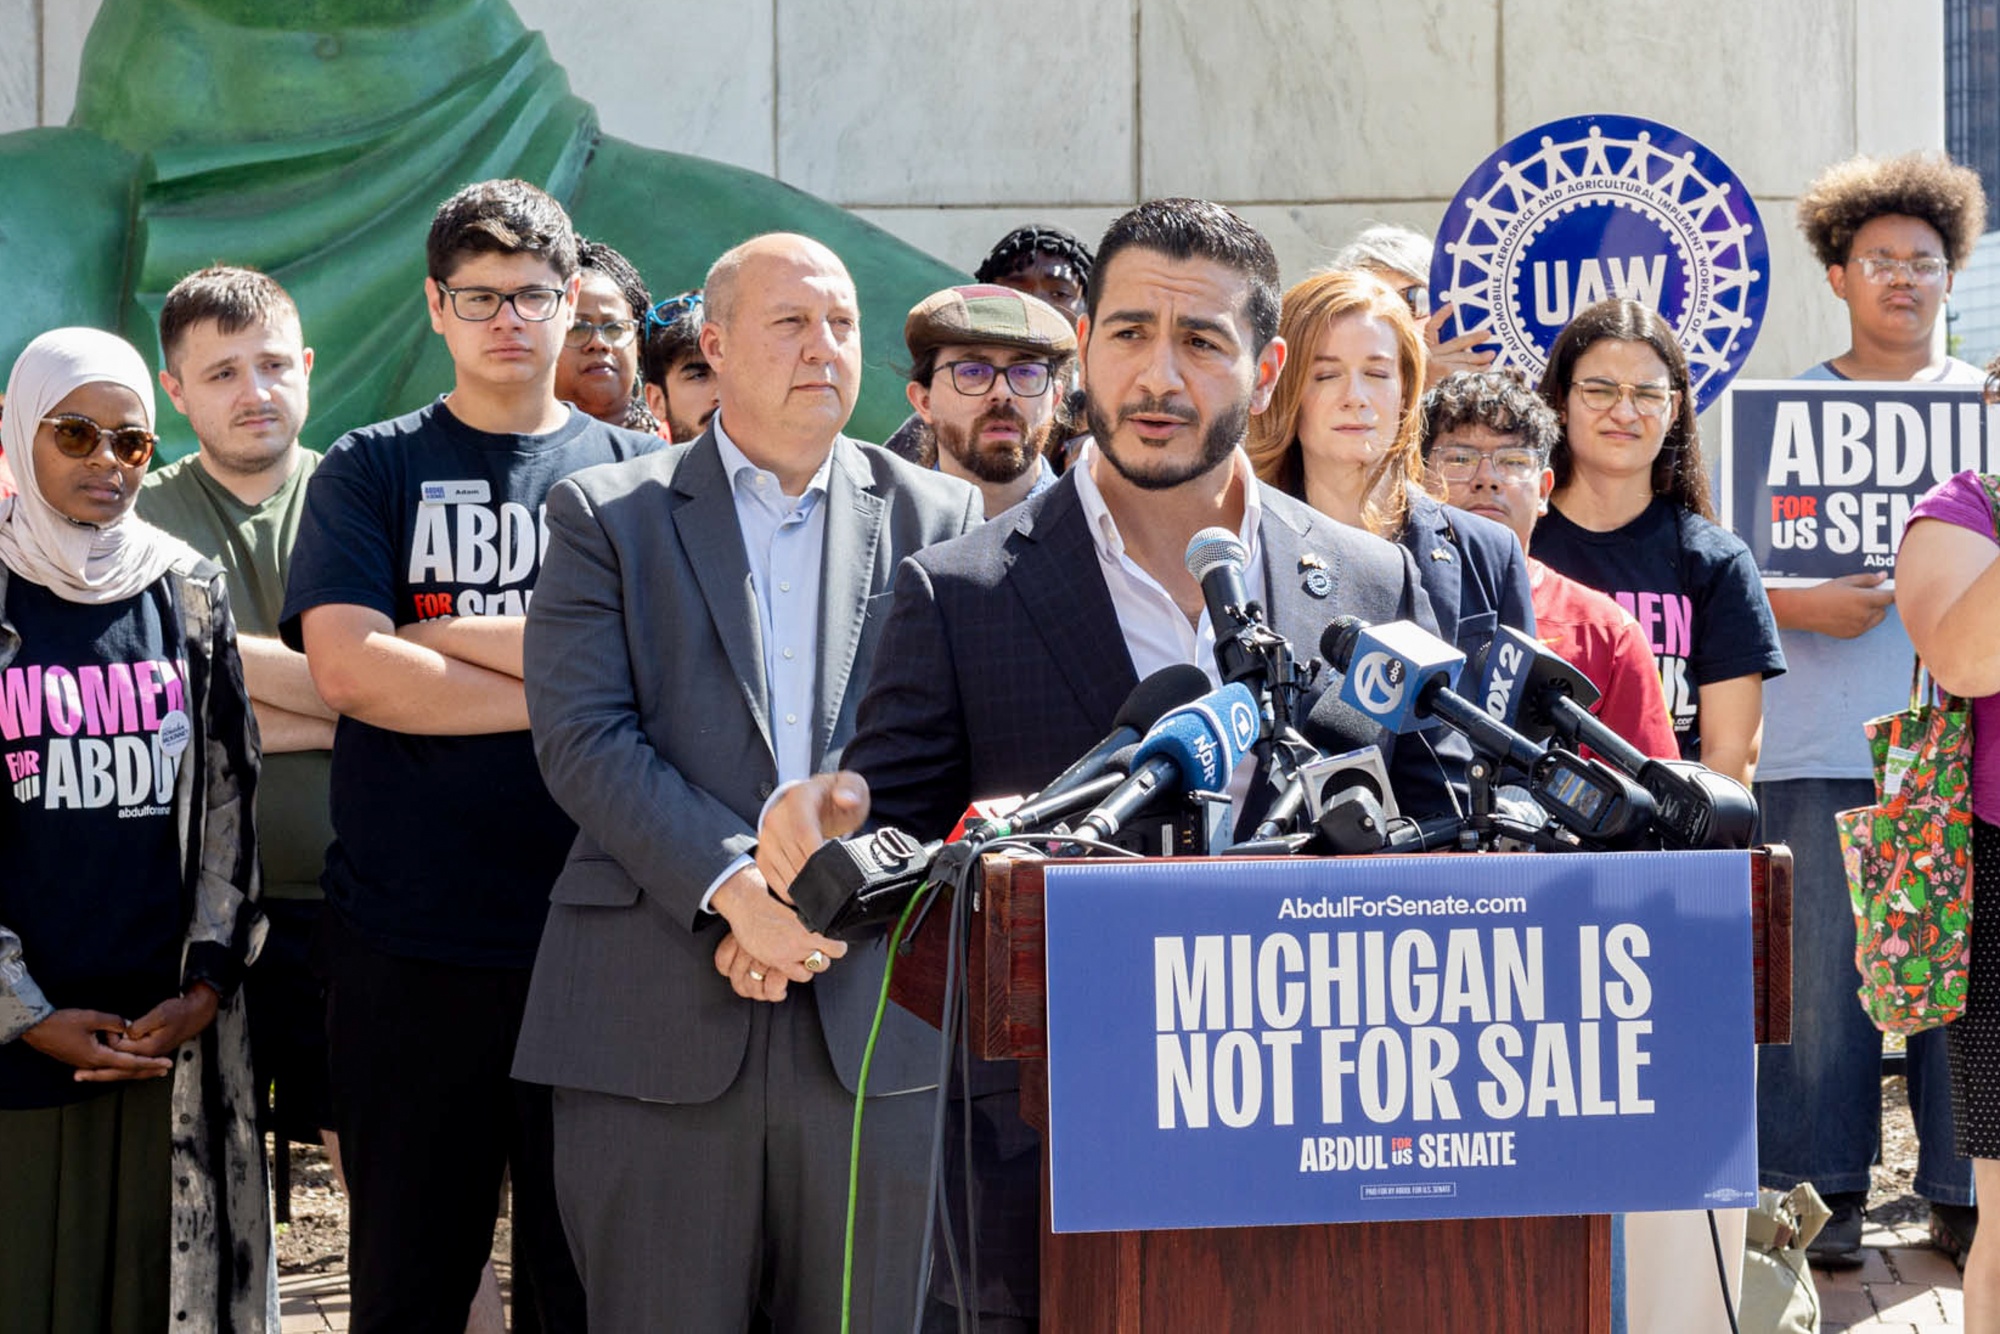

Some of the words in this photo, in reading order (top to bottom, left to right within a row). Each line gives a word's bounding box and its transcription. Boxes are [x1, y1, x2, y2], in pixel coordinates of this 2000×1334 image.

[1538, 189, 1563, 209] AND
[1567, 179, 1655, 201] AGRICULTURAL
[1496, 207, 1536, 269] AEROSPACE
[1657, 197, 1703, 251] IMPLEMENT
[1533, 254, 1669, 327] UAW
[1697, 256, 1710, 314] WORKERS
[1493, 273, 1520, 351] AUTOMOBILE,
[1691, 318, 1702, 334] OF
[1771, 495, 1818, 523] FOR
[1824, 491, 1923, 555] SEN
[408, 500, 550, 588] ABD
[1772, 517, 1819, 550] US
[1863, 554, 1895, 567] Abd
[413, 592, 453, 620] FOR
[1498, 642, 1525, 676] 2
[0, 659, 189, 742] WOMEN
[1486, 666, 1515, 722] OX
[5, 750, 41, 783] FOR
[44, 733, 182, 810] ABDU
[1193, 734, 1218, 783] NDR
[1277, 895, 1528, 920] AbdulForSenate.com
[1154, 926, 1546, 1032] MICHIGAN
[1578, 922, 1653, 1020] IS
[1156, 1029, 1303, 1130] NOT
[1320, 1026, 1462, 1124] FOR
[1477, 1019, 1656, 1120] SALE
[1299, 1134, 1389, 1173] ABDUL
[1391, 1136, 1413, 1151] FOR
[1391, 1148, 1414, 1166] US
[1417, 1130, 1518, 1169] SENATE
